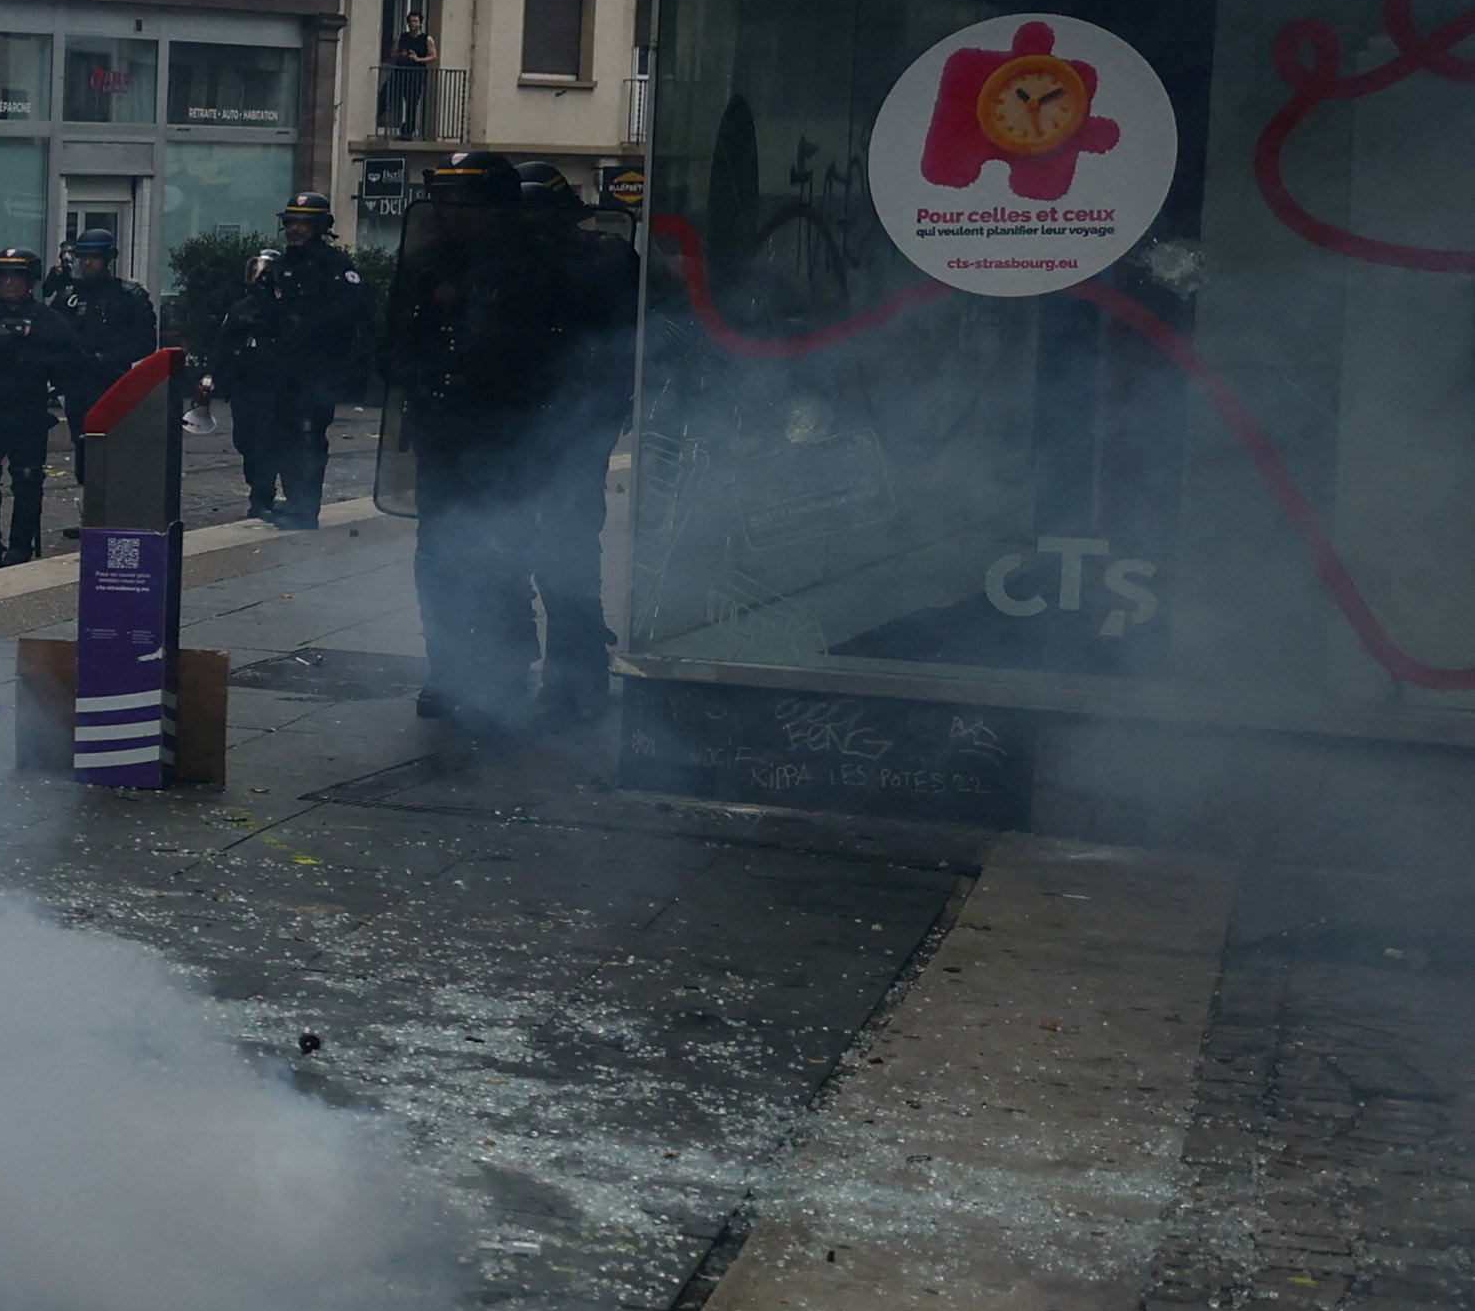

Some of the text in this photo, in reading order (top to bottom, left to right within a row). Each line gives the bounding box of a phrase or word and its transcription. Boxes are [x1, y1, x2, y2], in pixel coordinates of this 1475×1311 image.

[188, 108, 278, 120] RETRAITE AUTO HABITATION
[917, 206, 1116, 224] Pour celles et ceux
[916, 226, 1115, 238] qui veulent planifier leur voyage
[946, 257, 1078, 271] cts-strasbourg.eu
[984, 536, 1159, 636] CTS
